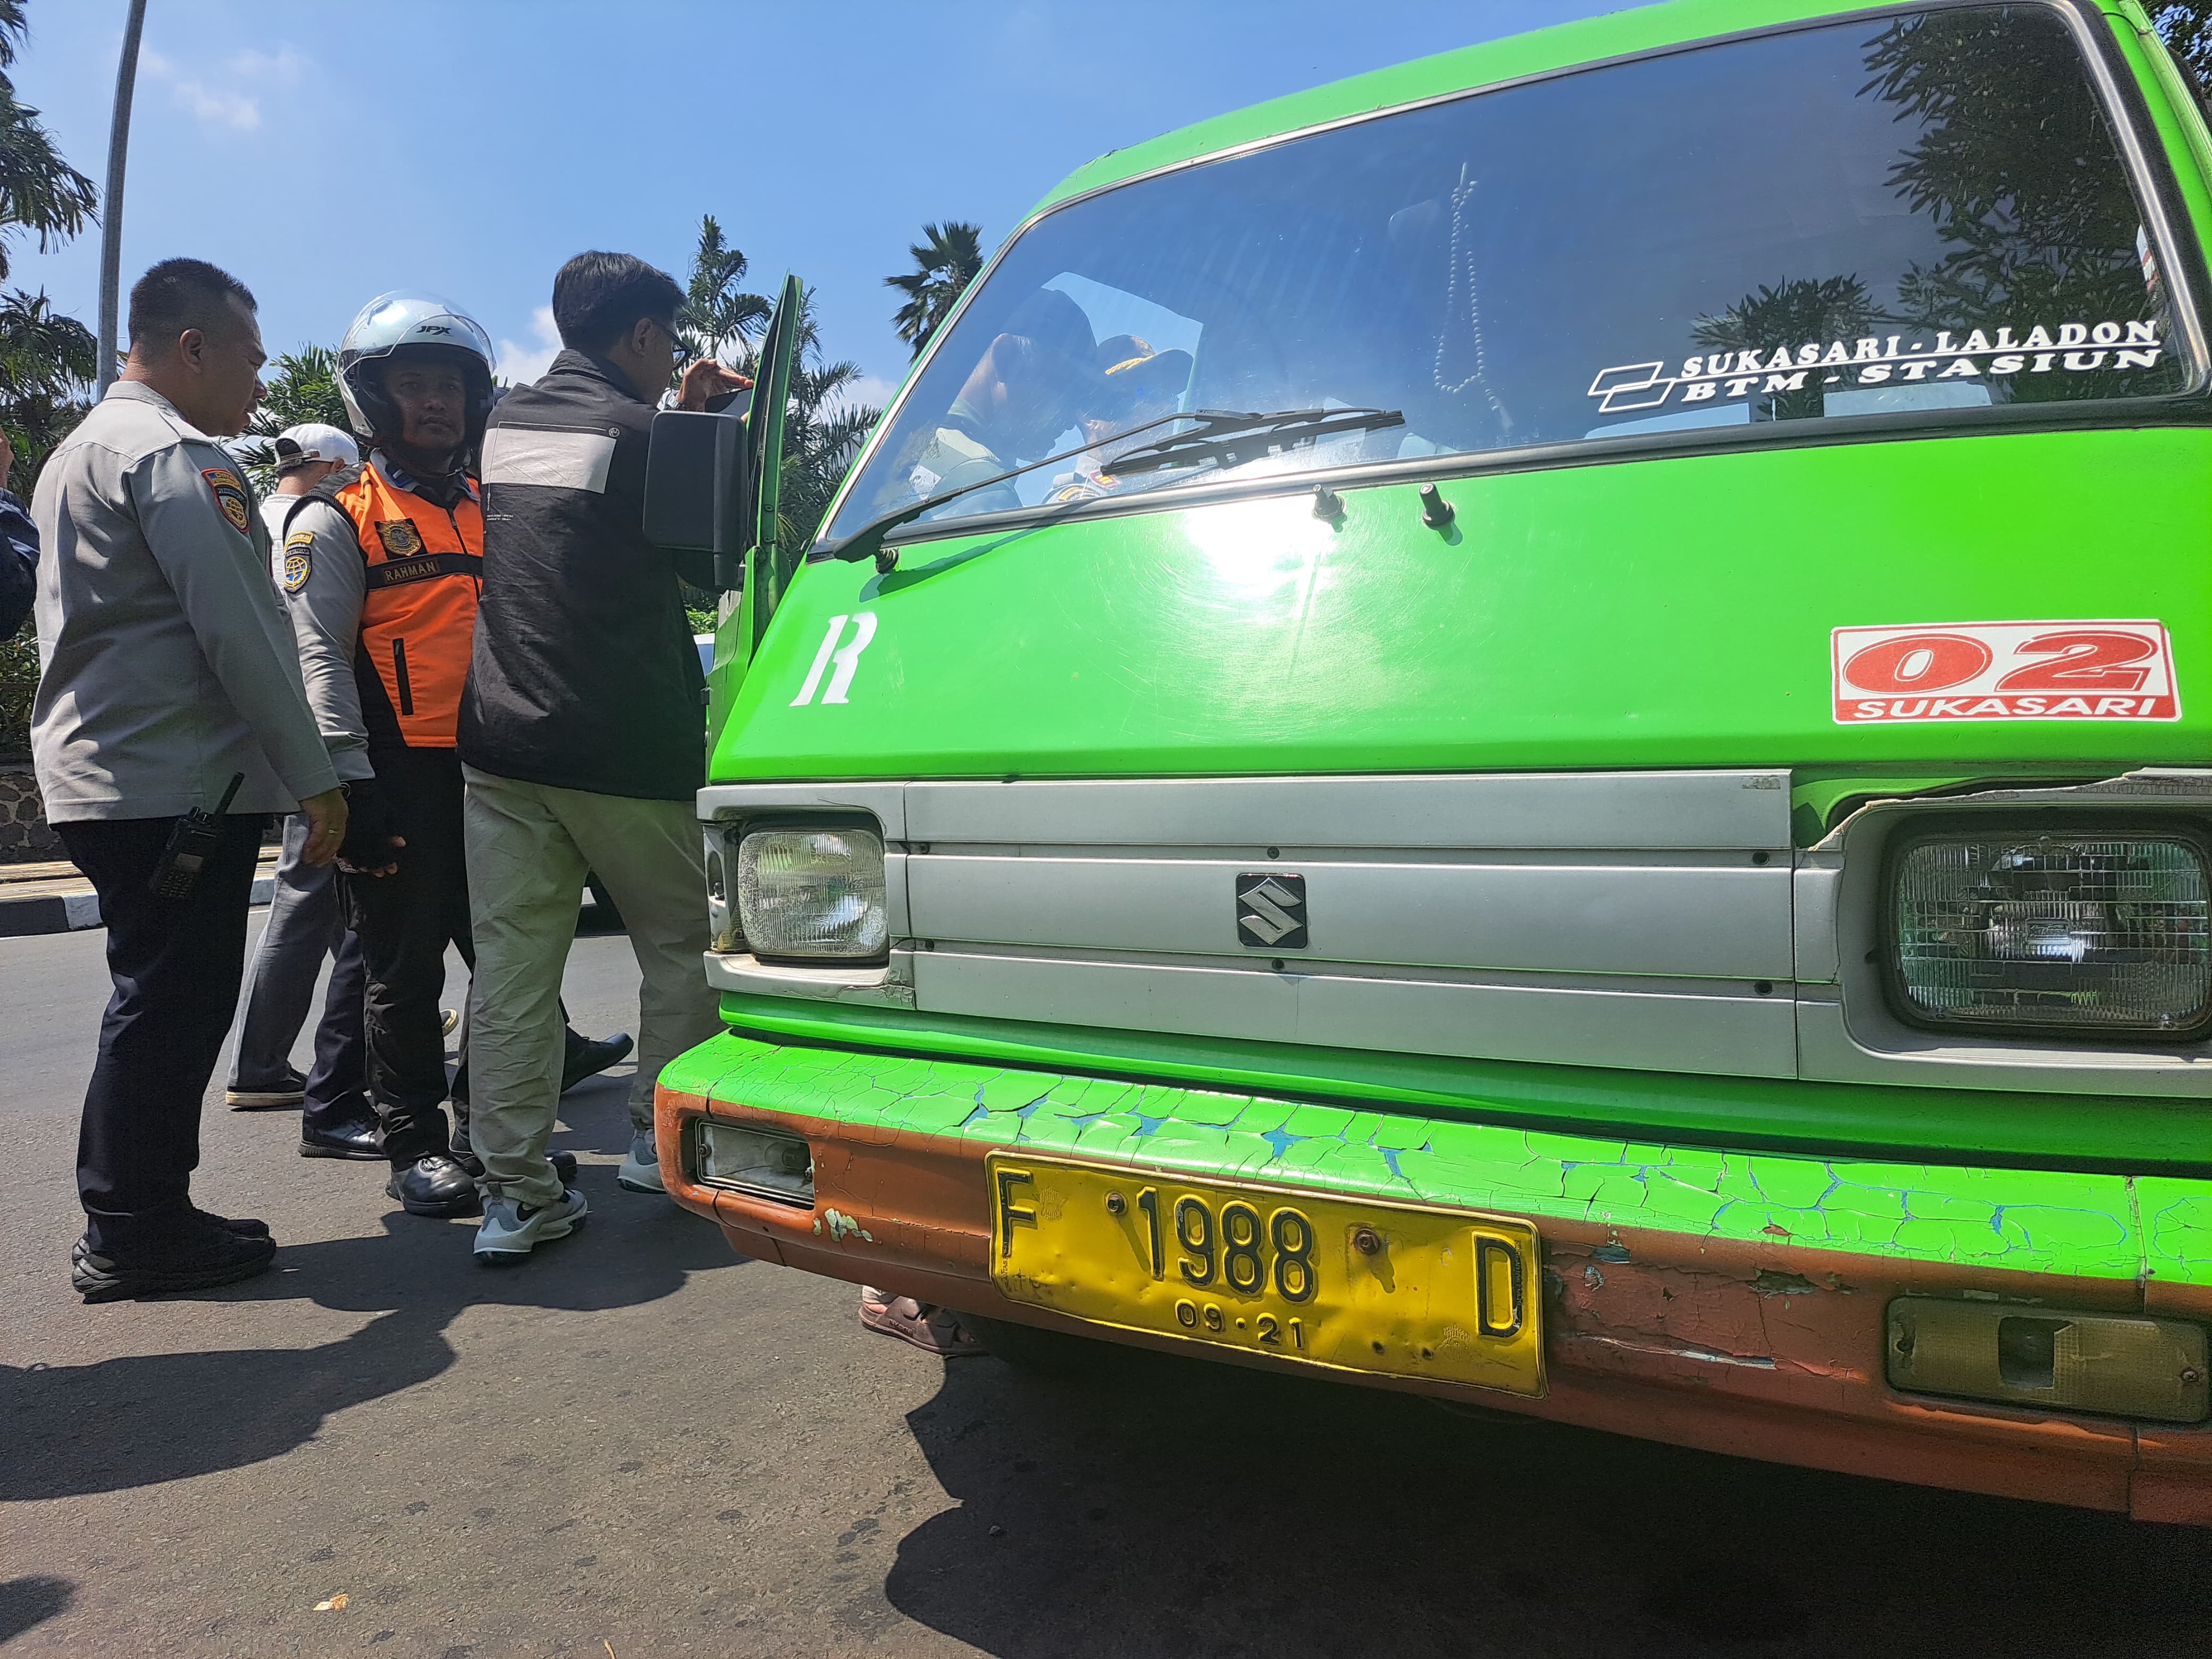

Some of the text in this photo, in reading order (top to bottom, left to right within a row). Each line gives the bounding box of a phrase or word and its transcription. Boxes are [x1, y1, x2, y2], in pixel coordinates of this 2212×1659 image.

[416, 325, 452, 335] JPX
[1681, 335, 1901, 378] SUKASARI
[1933, 320, 2157, 353] LALADON
[1680, 372, 1809, 403] BTM
[1857, 349, 2163, 383] STASIUN
[384, 561, 437, 582] RAHMAN
[789, 611, 878, 707] R
[1843, 630, 2159, 694] 02
[1853, 697, 2157, 718] SUKASARI
[996, 1167, 1523, 1338] F 1988 D
